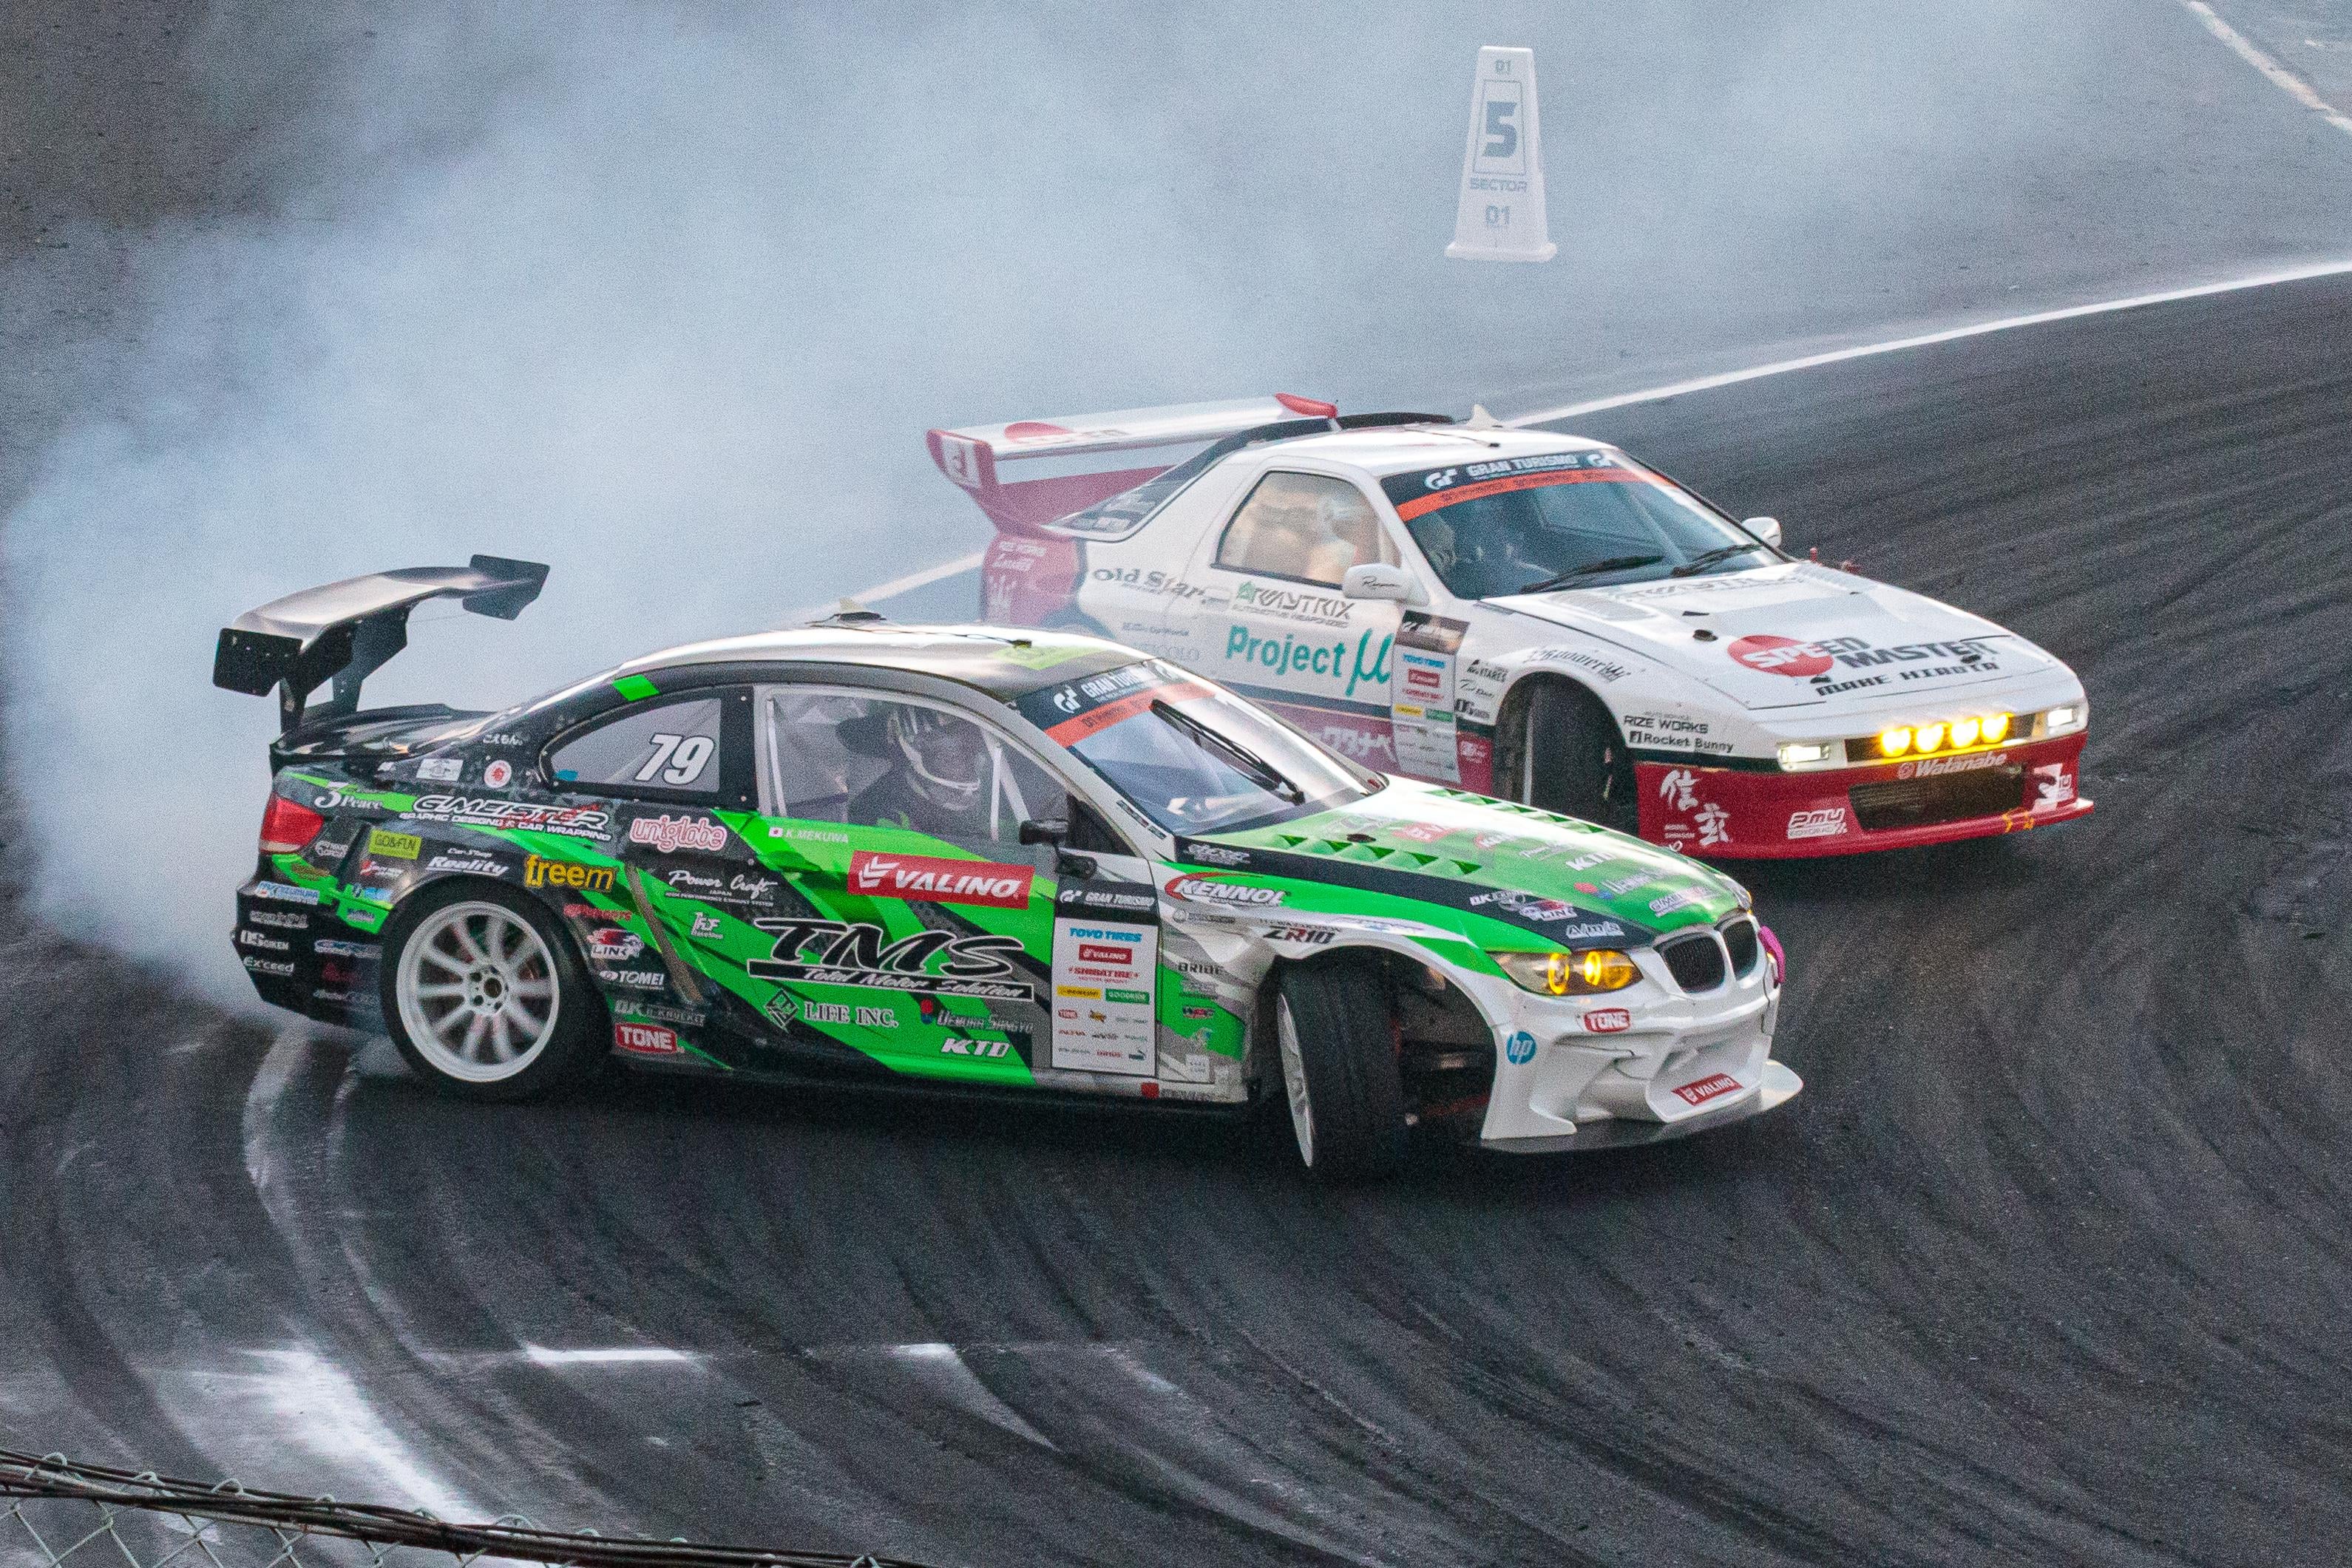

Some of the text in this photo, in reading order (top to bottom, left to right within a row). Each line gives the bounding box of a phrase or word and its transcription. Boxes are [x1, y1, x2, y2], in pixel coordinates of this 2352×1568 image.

[1482, 101, 1517, 158] 5
[1469, 177, 1528, 193] SECTOR
[1466, 461, 1511, 478] GRAN
[1511, 455, 1579, 470] TURISMO
[1094, 568, 1141, 583] Old
[1225, 625, 1346, 679] Project
[1741, 637, 1871, 669] SPEED
[1836, 639, 2002, 669] MASTER
[1080, 675, 1118, 699] GRAN
[1623, 715, 1709, 734] RIZE WORKS
[1643, 733, 1734, 753] Rocket Bunny
[634, 733, 716, 785] 79
[1914, 753, 2007, 777] Watanabe
[399, 812, 450, 822] GRAPHIC
[518, 821, 545, 832] CAR
[546, 825, 612, 842] WRAPPING
[629, 815, 728, 852] uniglobe
[430, 855, 509, 877] Reality
[525, 854, 617, 892] freem
[668, 869, 779, 900] Power Craft
[894, 869, 1020, 900] VALINO
[1174, 879, 1285, 905] KENNOL
[1085, 892, 1113, 903] GRAN
[1113, 893, 1155, 907] TURISMO
[1069, 928, 1142, 943] TOYO TIRES
[1262, 925, 1336, 944] ZR10
[753, 917, 1025, 979] TMS
[619, 970, 665, 985] TOMEI
[935, 978, 1024, 998] Solution
[803, 1000, 900, 1028] LIFE INC.
[1587, 1012, 1629, 1031] TONE
[620, 1026, 673, 1050] TONE
[1509, 1031, 1533, 1065] hp
[1694, 1077, 1735, 1097] VALINO
